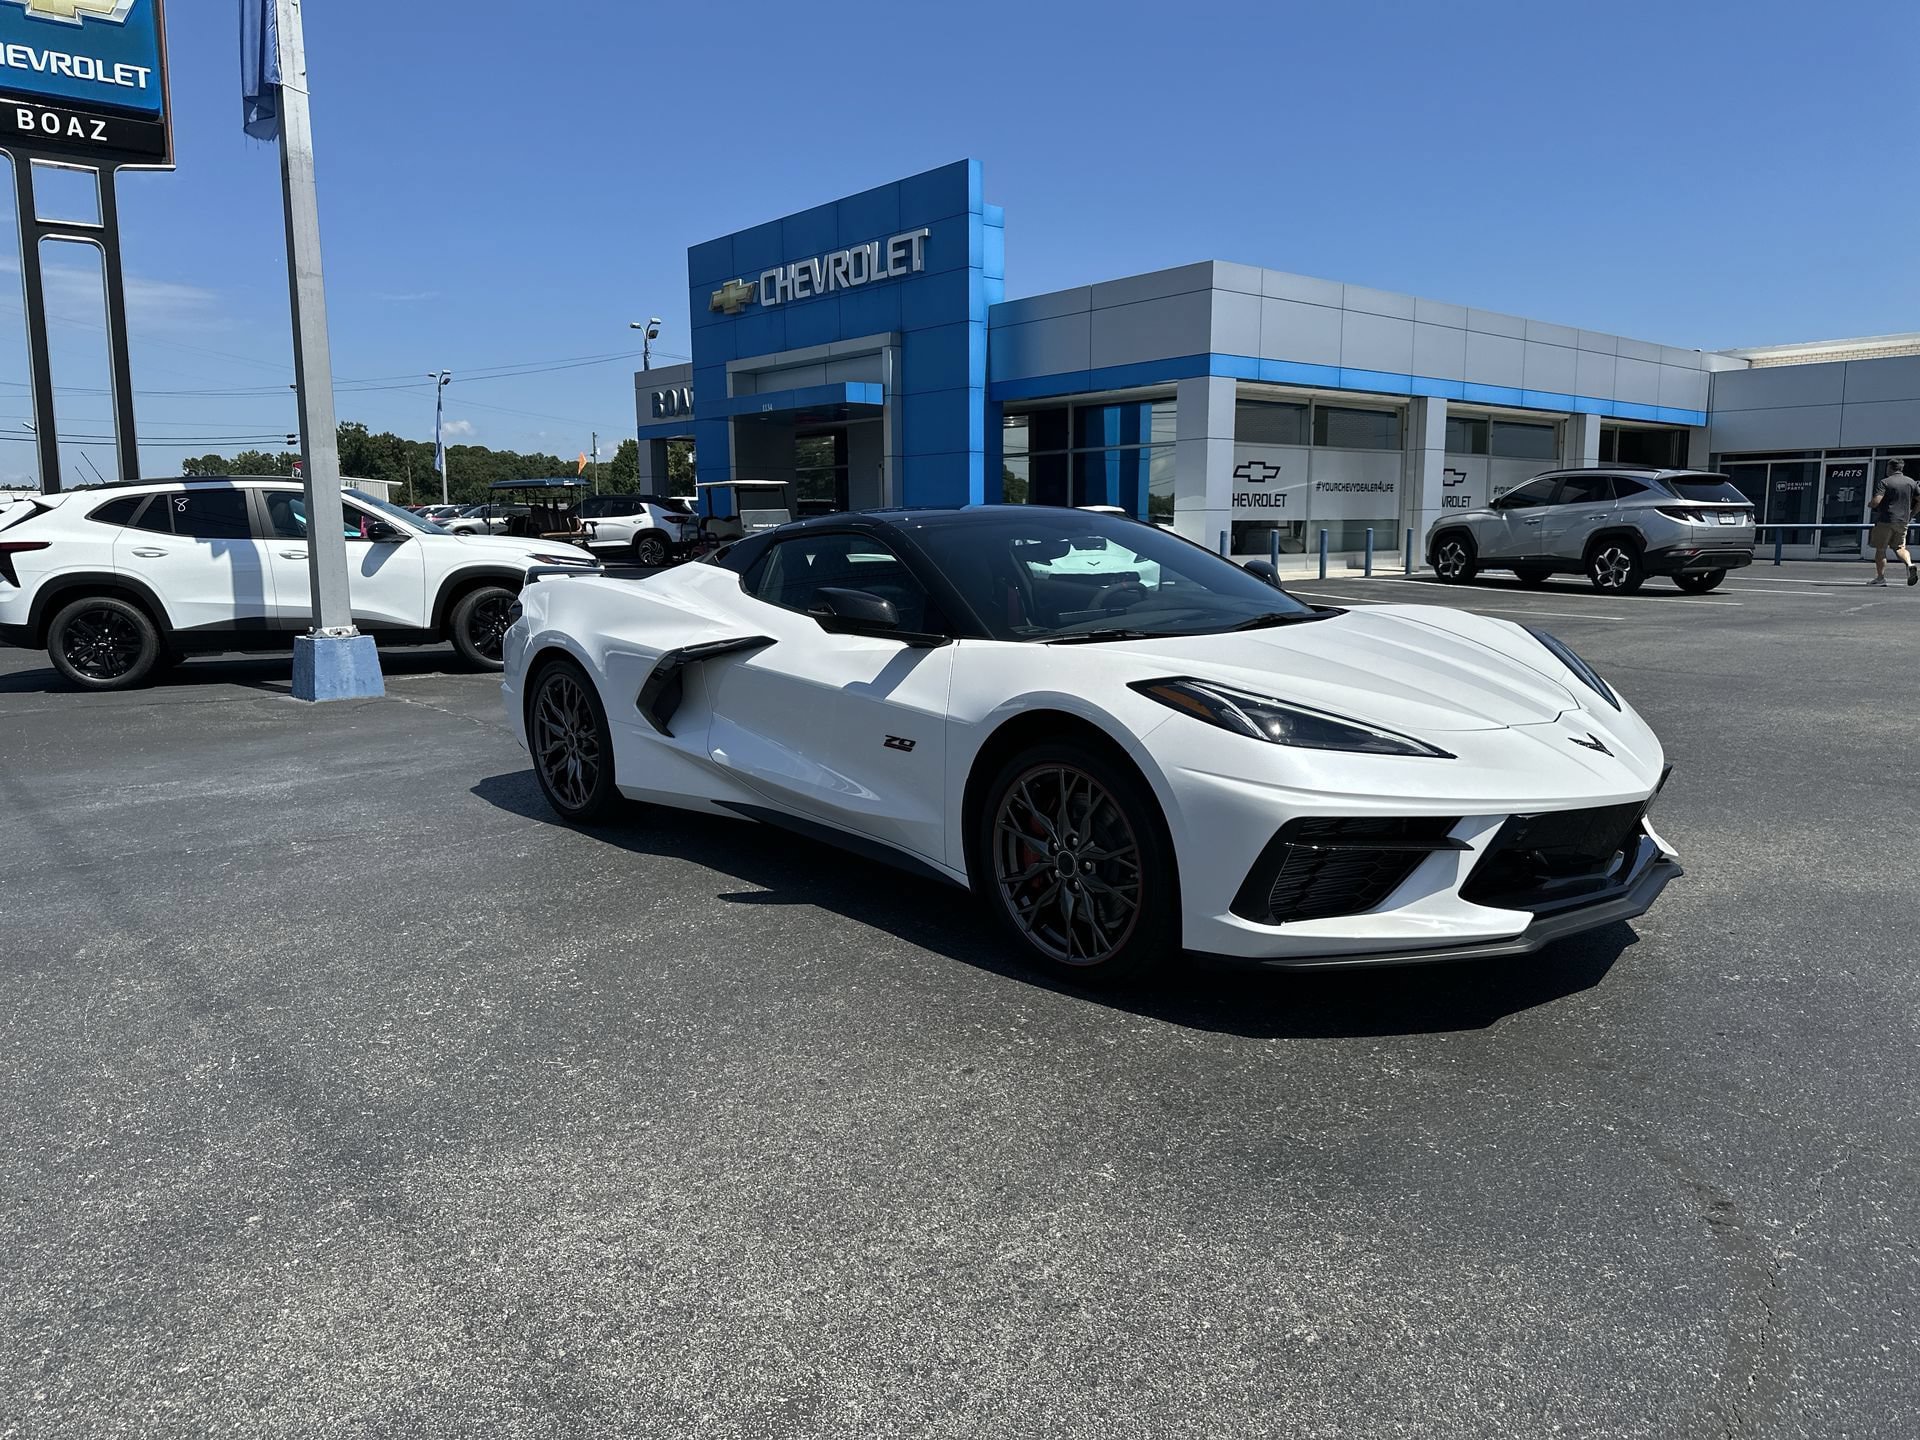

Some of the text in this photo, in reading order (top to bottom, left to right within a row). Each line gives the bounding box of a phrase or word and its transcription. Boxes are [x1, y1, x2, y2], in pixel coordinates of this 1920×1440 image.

[0, 41, 151, 89] EVROLET
[16, 107, 108, 142] BOAZ
[759, 228, 929, 307] CHEVROLET
[651, 386, 695, 419] BOA
[1315, 481, 1394, 493] #YOURCHEVYDEALER4LIFE
[1832, 469, 1862, 478] PARTS
